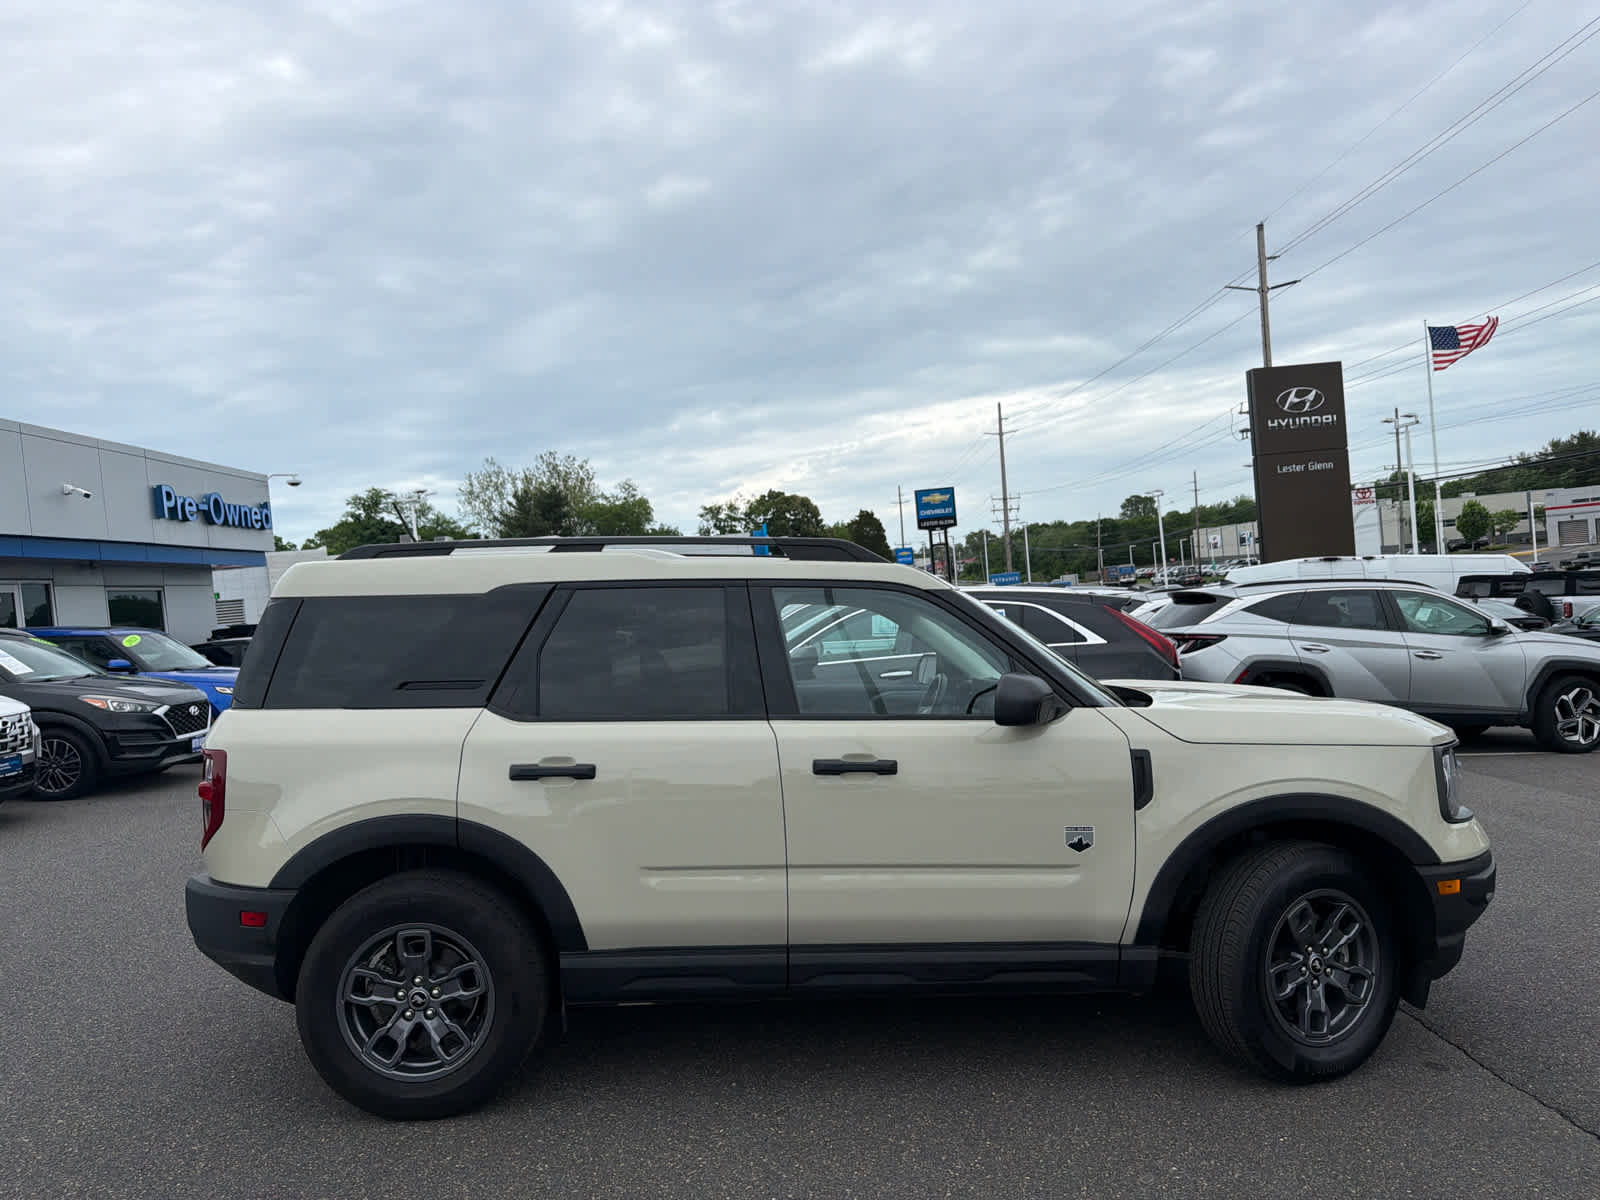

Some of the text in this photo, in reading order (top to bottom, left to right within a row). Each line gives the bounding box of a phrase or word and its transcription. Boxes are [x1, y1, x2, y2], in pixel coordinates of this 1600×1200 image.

[1267, 414, 1337, 428] HYUNDAI
[1277, 461, 1334, 474] Lester Glenn
[154, 484, 272, 530] Pre-Owned
[920, 507, 953, 517] CHEVROLET
